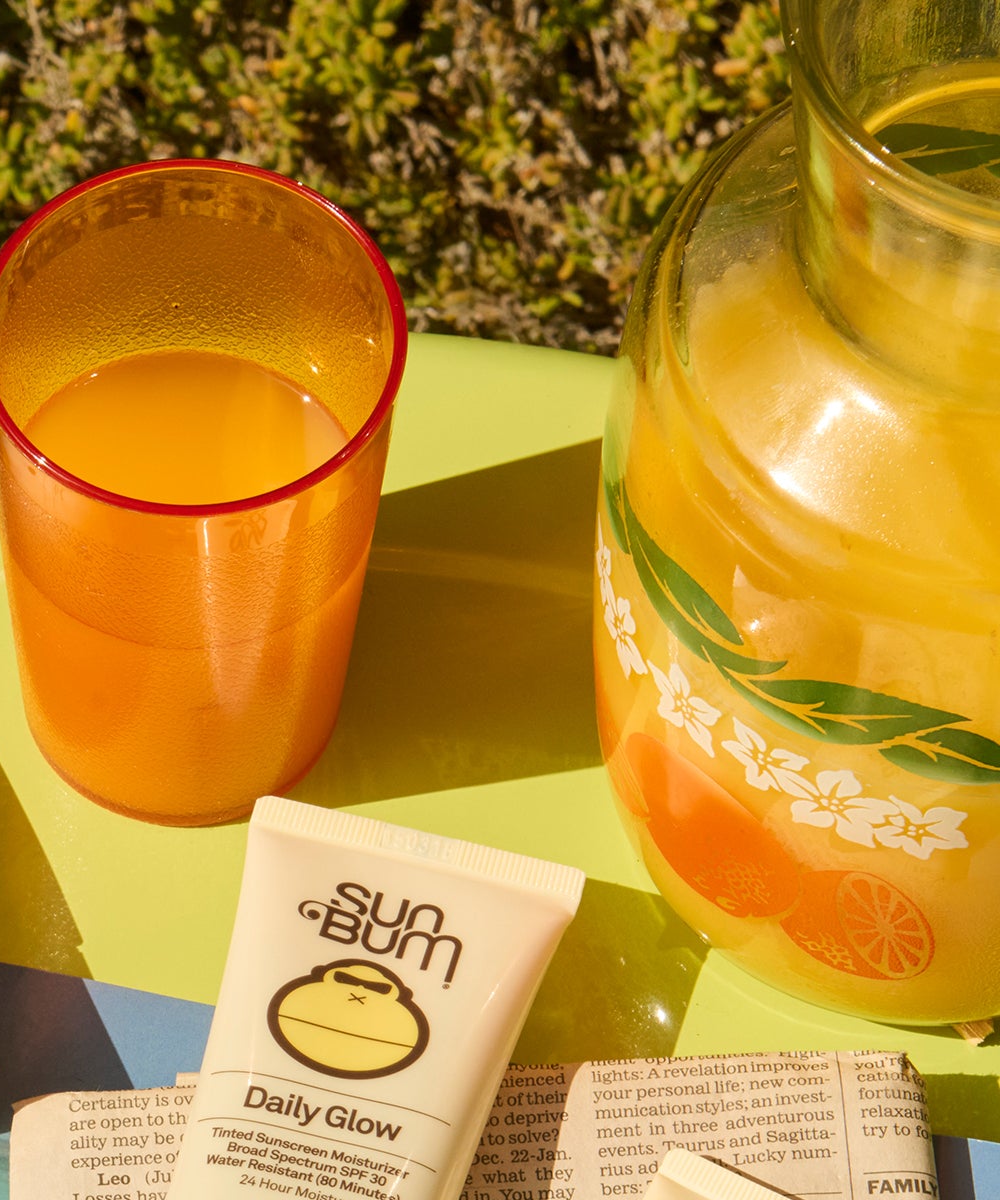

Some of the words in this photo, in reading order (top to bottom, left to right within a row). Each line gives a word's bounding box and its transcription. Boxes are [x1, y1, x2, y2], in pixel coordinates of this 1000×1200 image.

[592, 1070, 643, 1085] lights:
[647, 1068, 660, 1079] A
[663, 1063, 748, 1078] revelation
[751, 1062, 829, 1073] improves
[593, 1089, 632, 1103] your
[636, 1082, 711, 1101] personal
[714, 1080, 744, 1094] life;
[750, 1079, 784, 1090] new
[788, 1077, 830, 1086] com-
[243, 1086, 322, 1126] Daily
[325, 1105, 402, 1141] Glow
[212, 1127, 254, 1141] Tinted
[256, 1132, 328, 1158] Sunscreen
[330, 1150, 409, 1179] Moisturizer
[227, 1141, 268, 1157] Broad
[270, 1149, 337, 1174] Spectrum
[339, 1166, 369, 1180] SPF
[369, 1173, 387, 1186] 30
[207, 1154, 246, 1167] Water
[248, 1159, 314, 1182] Resistant
[316, 1173, 338, 1188] (80
[240, 1174, 256, 1186] 24
[259, 1178, 293, 1193] Hour
[868, 1179, 937, 1198] FAMILY
